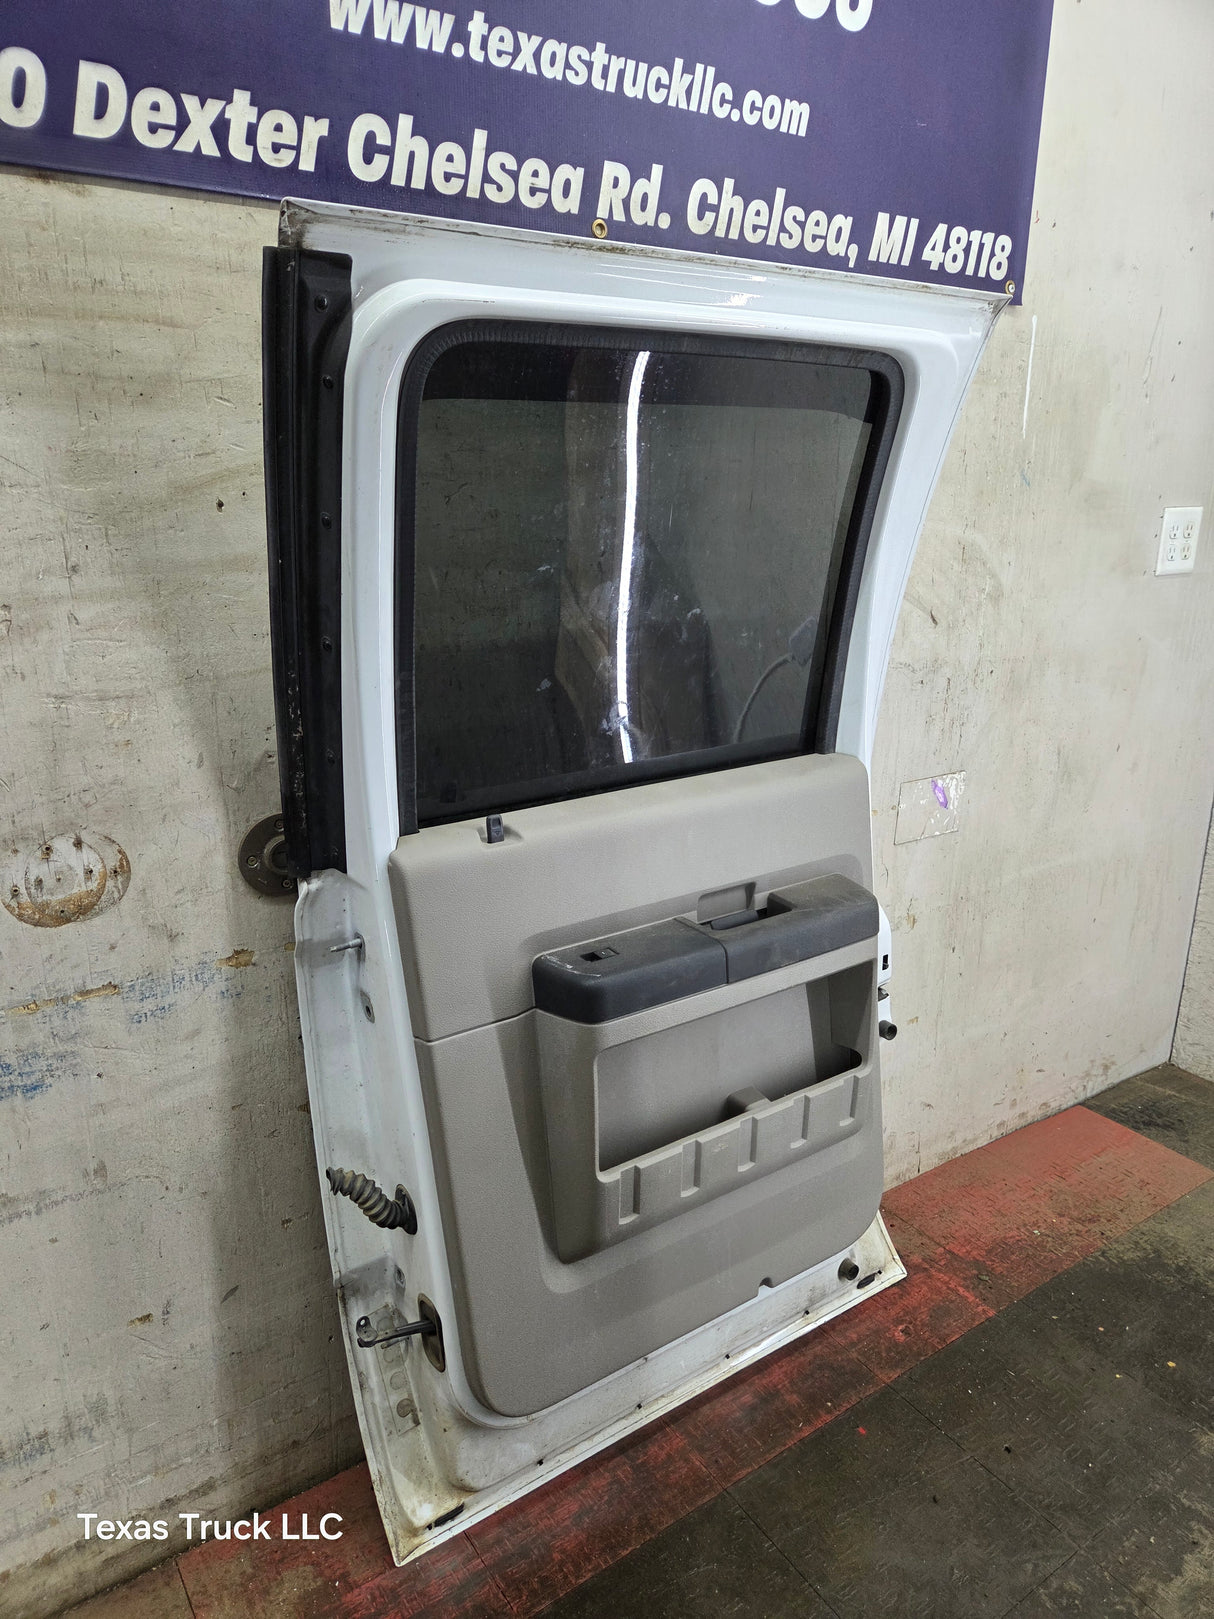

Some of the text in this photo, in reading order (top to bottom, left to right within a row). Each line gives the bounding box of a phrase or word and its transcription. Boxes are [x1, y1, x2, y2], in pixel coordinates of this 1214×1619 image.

[329, 0, 811, 138] www.texastruckllc.com
[73, 59, 330, 173] Dexter
[348, 112, 585, 214] Chelsea
[597, 160, 672, 230] Rd.
[687, 177, 854, 269] Chelsea,
[867, 211, 920, 267] MI
[921, 222, 1013, 281] 48118
